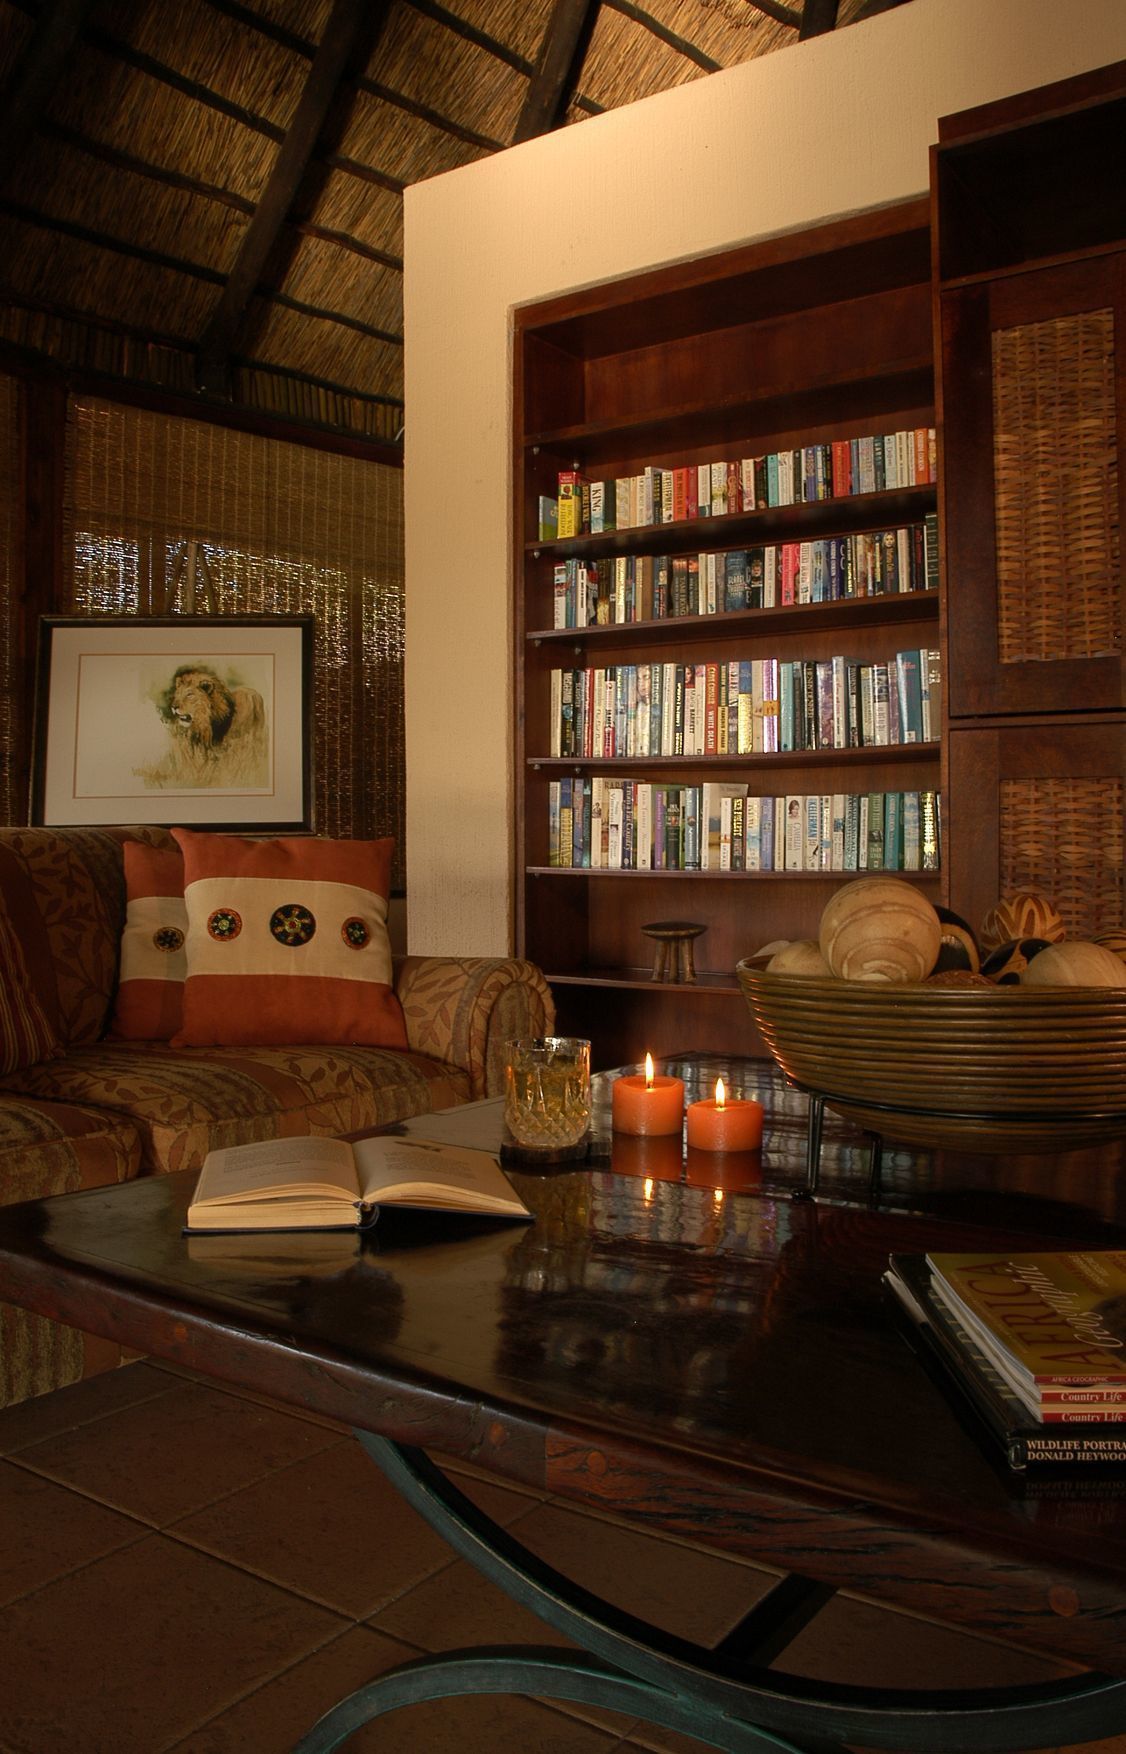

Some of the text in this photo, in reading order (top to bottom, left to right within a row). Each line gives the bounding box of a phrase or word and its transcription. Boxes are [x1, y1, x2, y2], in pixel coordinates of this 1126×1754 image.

[592, 488, 602, 512] KING
[679, 575, 687, 616] TAMI HOAG
[707, 667, 716, 704] CLIVE CUSSLER
[806, 667, 814, 690] HENRY
[707, 710, 715, 749] WHITE DEATH
[625, 786, 633, 805] From
[808, 801, 817, 838] KELLERMAN
[623, 822, 633, 851] Country
[956, 1261, 1121, 1370] AFRICA
[1060, 1391, 1123, 1403] Country Life
[1061, 1412, 1124, 1423] Country Life
[1027, 1440, 1081, 1450] WILDLIFE
[1027, 1452, 1074, 1461] DONALD
